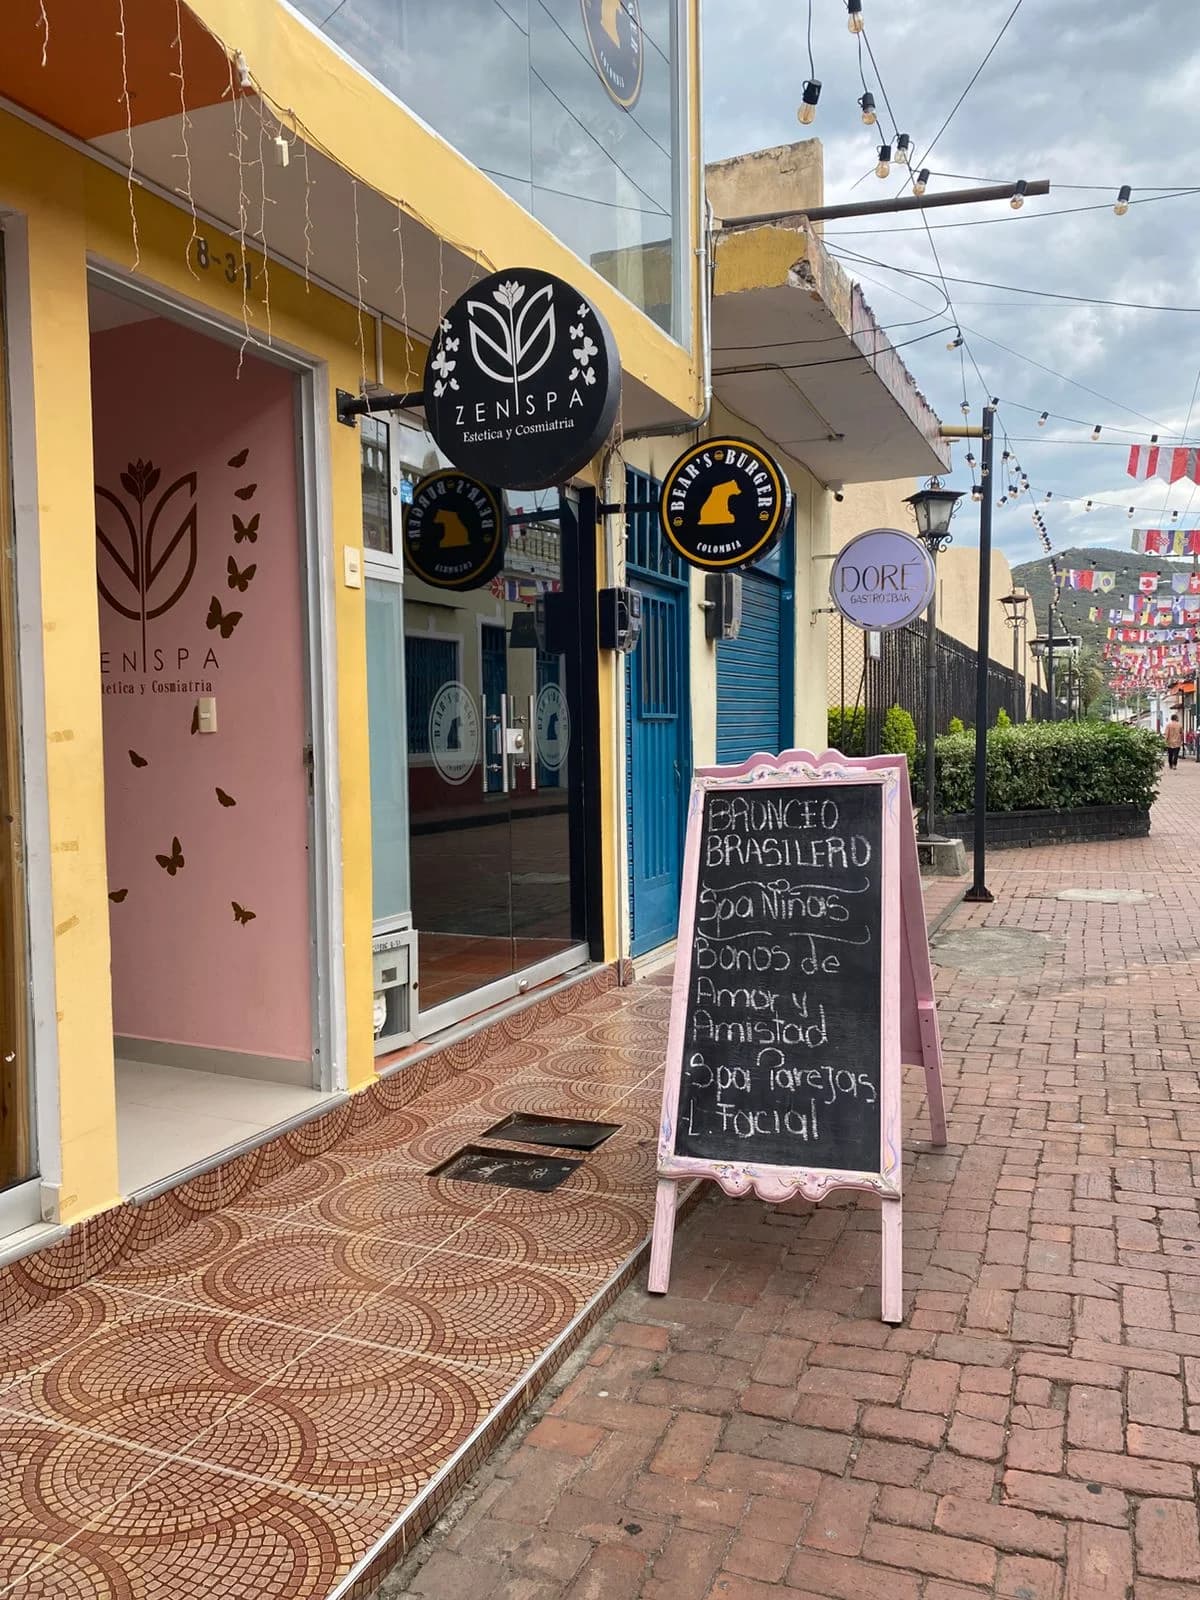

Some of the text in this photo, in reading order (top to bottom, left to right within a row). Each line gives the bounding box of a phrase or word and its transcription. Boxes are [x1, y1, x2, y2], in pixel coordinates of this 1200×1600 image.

[197, 238, 251, 290] 8-31
[463, 417, 575, 443] Estetica y Cosmiatria
[670, 449, 773, 511] BEAR'S BURGER
[696, 540, 742, 554] COLOMBIA
[841, 556, 921, 593] DORÉ
[151, 680, 212, 693] Cosmiatria
[699, 888, 850, 936] Spa Niñas
[694, 934, 840, 974] Bonos de
[697, 976, 808, 1018] Amor y
[693, 1004, 828, 1048] Amistad
[716, 1098, 819, 1141] Facial
